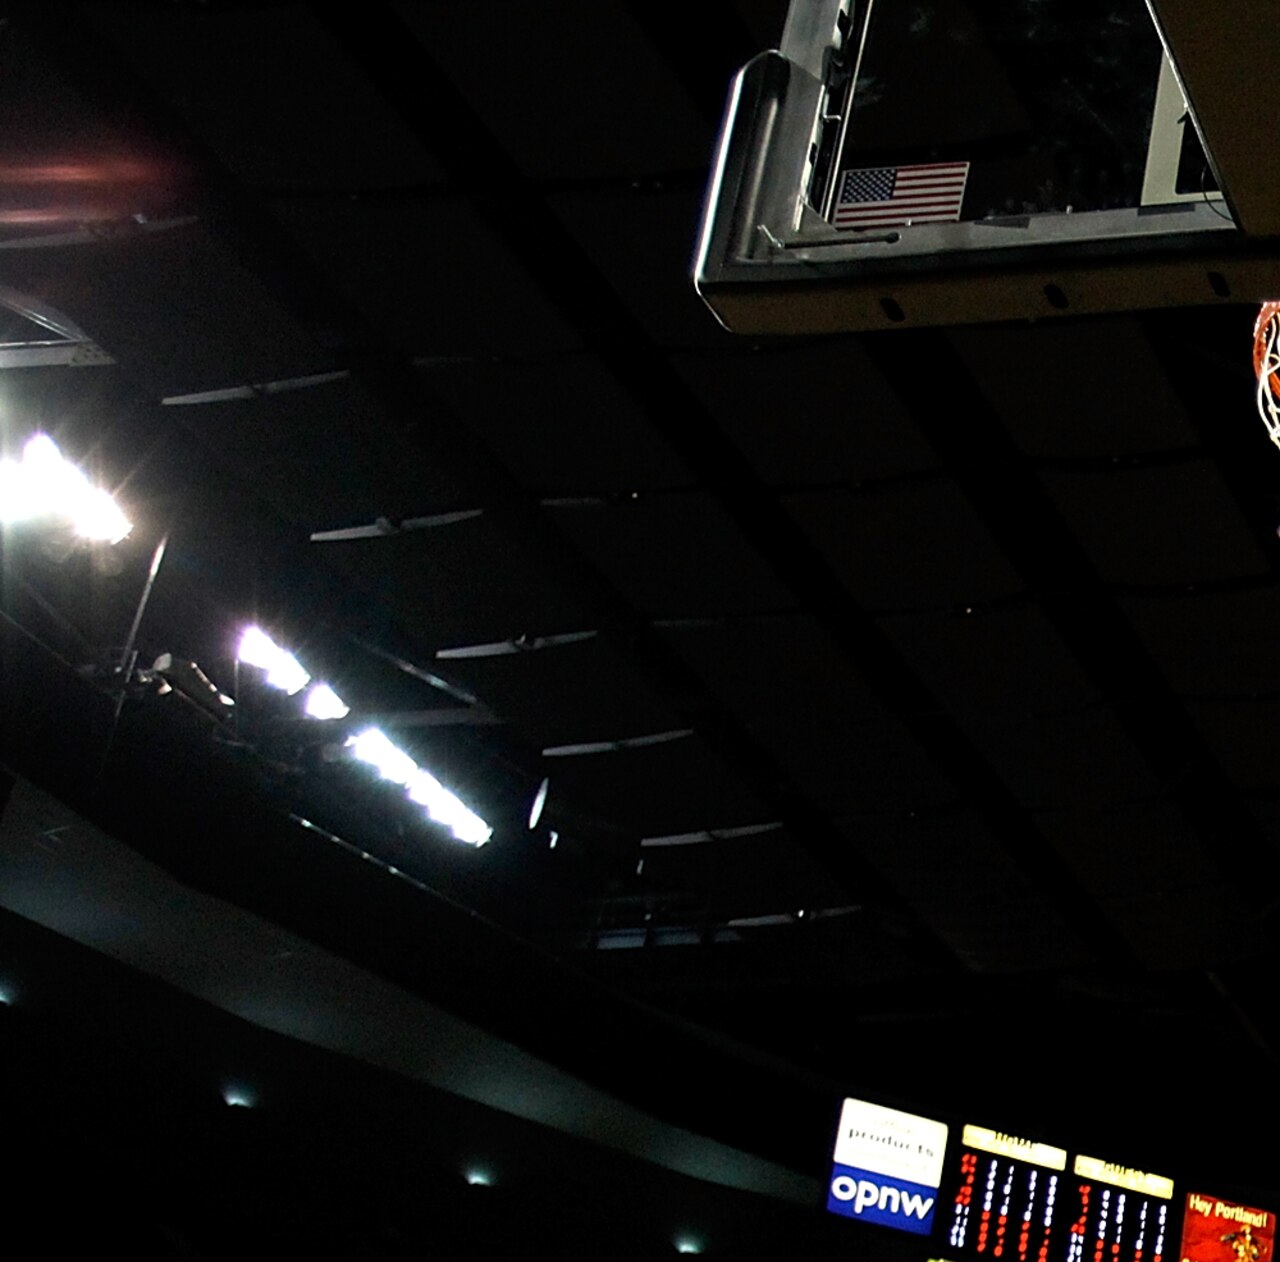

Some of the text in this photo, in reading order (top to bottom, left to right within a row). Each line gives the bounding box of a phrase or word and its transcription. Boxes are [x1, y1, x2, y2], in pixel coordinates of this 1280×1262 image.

[848, 1127, 935, 1160] products
[832, 1176, 934, 1219] opnw
[1189, 1194, 1268, 1228] Hey Portland!
